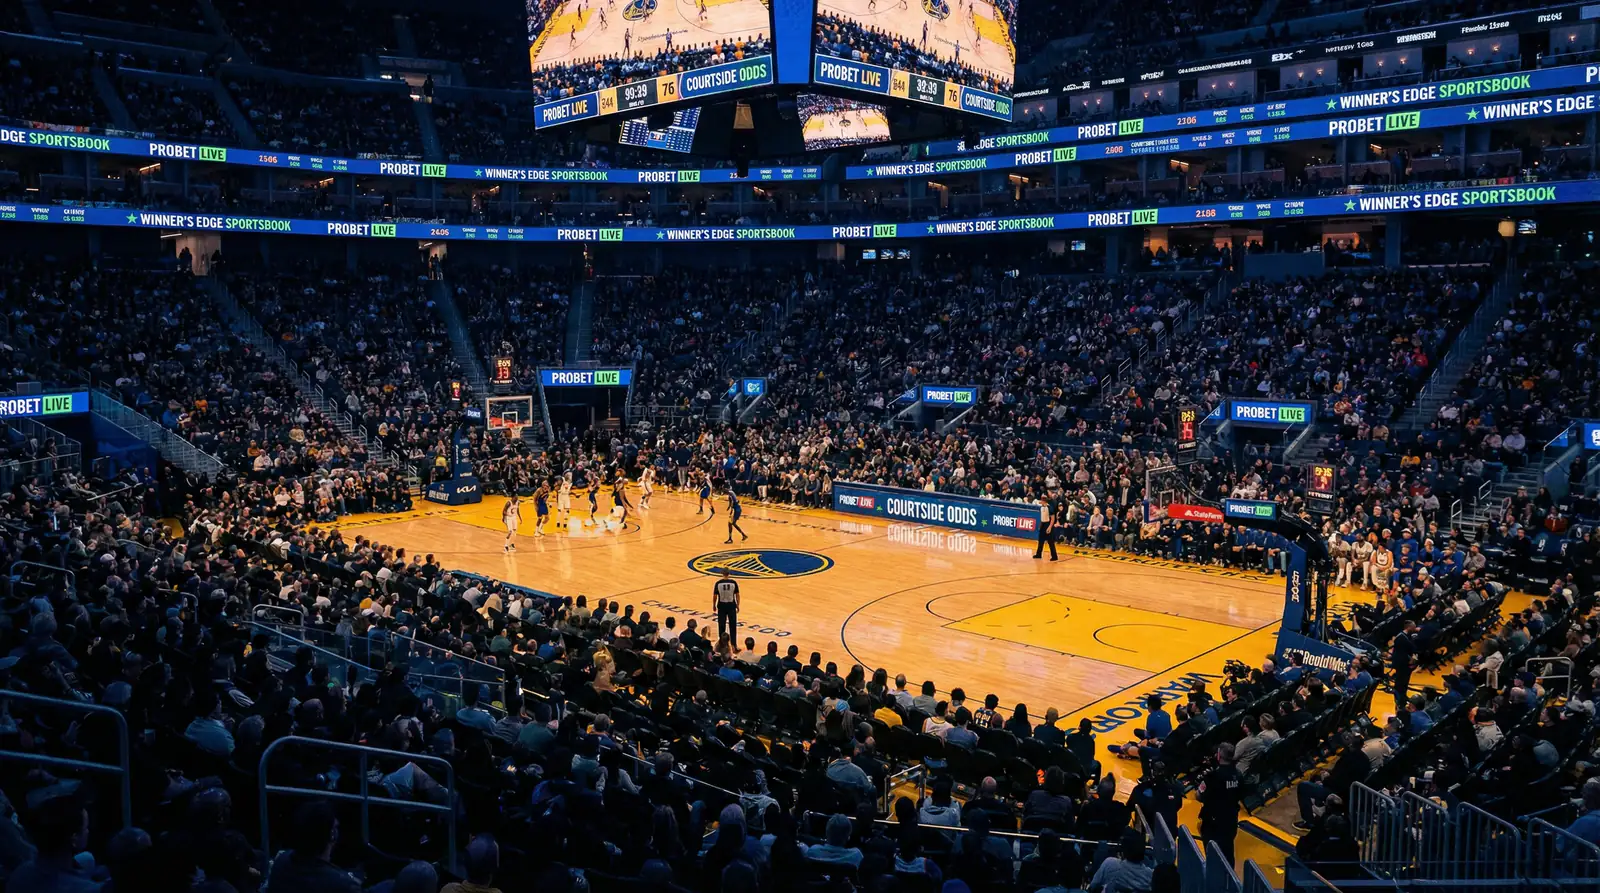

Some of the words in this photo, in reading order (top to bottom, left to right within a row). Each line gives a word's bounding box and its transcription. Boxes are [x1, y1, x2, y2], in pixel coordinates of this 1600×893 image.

[686, 69, 737, 91] COURTSIDE
[739, 64, 767, 81] ODDS
[820, 62, 859, 83] PROBET
[861, 70, 881, 87] LIVE
[662, 82, 675, 96] 76
[949, 90, 958, 102] 76
[1340, 91, 1400, 108] WINNER'S
[1403, 86, 1436, 102] EDGE
[1439, 75, 1531, 98] SPORTSBOOK
[543, 103, 570, 122] PROBET
[571, 99, 588, 115] LIVE
[965, 94, 995, 110] COURTSIDE
[996, 100, 1009, 114] ODDS
[1483, 100, 1552, 119] WINNER'S
[1557, 95, 1594, 112] EDGE
[1078, 123, 1117, 138] PROBET
[1120, 120, 1142, 134] LIVE
[1329, 117, 1383, 135] PROBET
[1388, 113, 1417, 128] LIVE
[29, 133, 110, 151] SPORTSBOOK
[974, 138, 995, 150] DGE
[997, 132, 1048, 147] SPORTSBOOK
[150, 143, 196, 158] PROBET
[201, 148, 225, 160] LIVE
[1016, 151, 1051, 165] PROBET
[1054, 148, 1075, 161] LIVE
[381, 163, 420, 175] PROBET
[424, 165, 445, 177] LIVE
[876, 165, 913, 175] WINNER'S
[915, 163, 934, 173] EDGE
[936, 158, 986, 172] SPORTSBOOK
[485, 169, 526, 179] WINNER'S
[528, 170, 549, 179] EDGE
[552, 171, 607, 180] SPORTSBOOK
[639, 172, 675, 182] PROBET
[679, 171, 699, 181] LIVE
[1360, 195, 1421, 210] WINNER'S
[1425, 193, 1458, 207] EDGE
[1462, 187, 1556, 205] SPORTSBOOK
[141, 214, 194, 227] WINNER'S
[197, 217, 223, 228] EDGE
[226, 218, 290, 231] SPORTSBOOK
[937, 222, 973, 233] WINNER'S
[976, 221, 996, 231] EDGE
[998, 217, 1054, 230] SPORTSBOOK
[1088, 212, 1130, 226] PROBET
[1133, 211, 1156, 223] LIVE
[328, 223, 369, 235] PROBET
[373, 225, 394, 235] LIVE
[558, 229, 597, 240] PROBET
[601, 229, 621, 240] LIVE
[667, 230, 709, 239] WINNER'S
[712, 230, 734, 239] EDGE
[737, 228, 794, 238] SPORTSBOOK
[833, 226, 871, 237] PROBET
[875, 225, 895, 236] LIVE
[552, 372, 592, 383] PROBET
[596, 372, 617, 383] LIVE
[927, 390, 953, 400] PROBET
[956, 392, 970, 402] LIVE
[45, 397, 70, 411] LIVE
[1237, 406, 1276, 418] PROBET
[1281, 409, 1303, 420] LIVE
[839, 494, 858, 506] PROBET
[887, 497, 944, 522] COURTSIDE
[947, 505, 977, 526] ODDS
[1230, 505, 1257, 514] PROBET
[993, 515, 1018, 528] PROBET
[1019, 518, 1034, 529] LIVE
